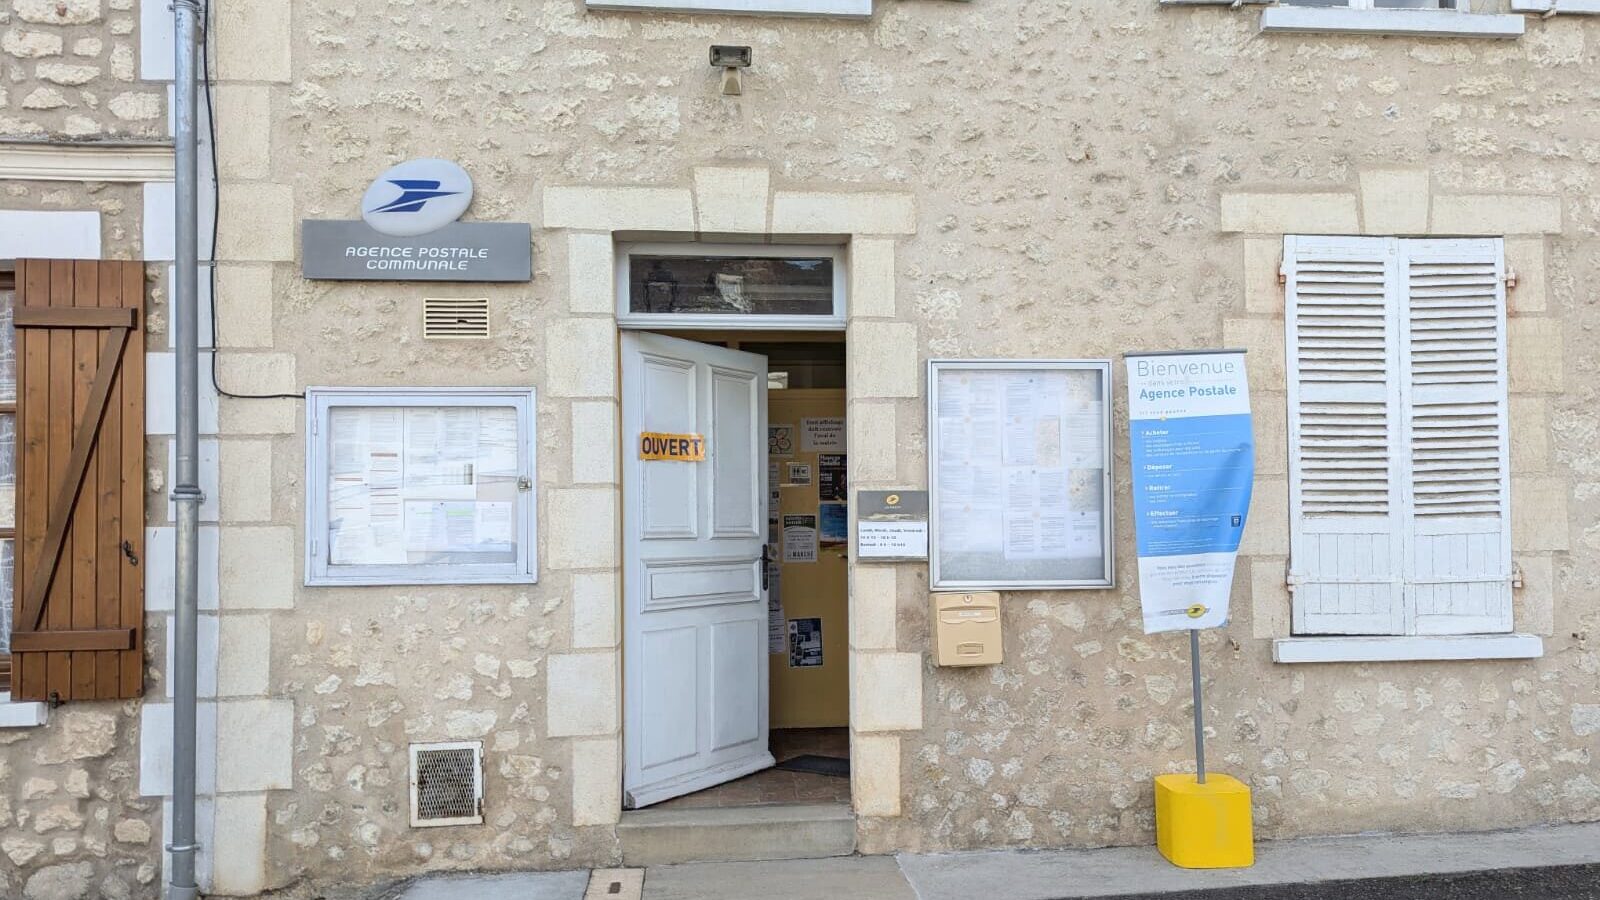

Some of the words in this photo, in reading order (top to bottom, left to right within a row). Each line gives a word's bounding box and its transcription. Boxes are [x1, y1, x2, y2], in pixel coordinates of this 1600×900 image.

[345, 246, 412, 258] AGENCE
[419, 247, 489, 259] POSTALE
[366, 259, 469, 271] COMMUNALE
[1137, 360, 1235, 377] Bienvenue
[1139, 388, 1185, 401] Agence
[1189, 384, 1237, 397] Postale
[1145, 429, 1169, 437] Acheter
[642, 436, 702, 456] OUVERT
